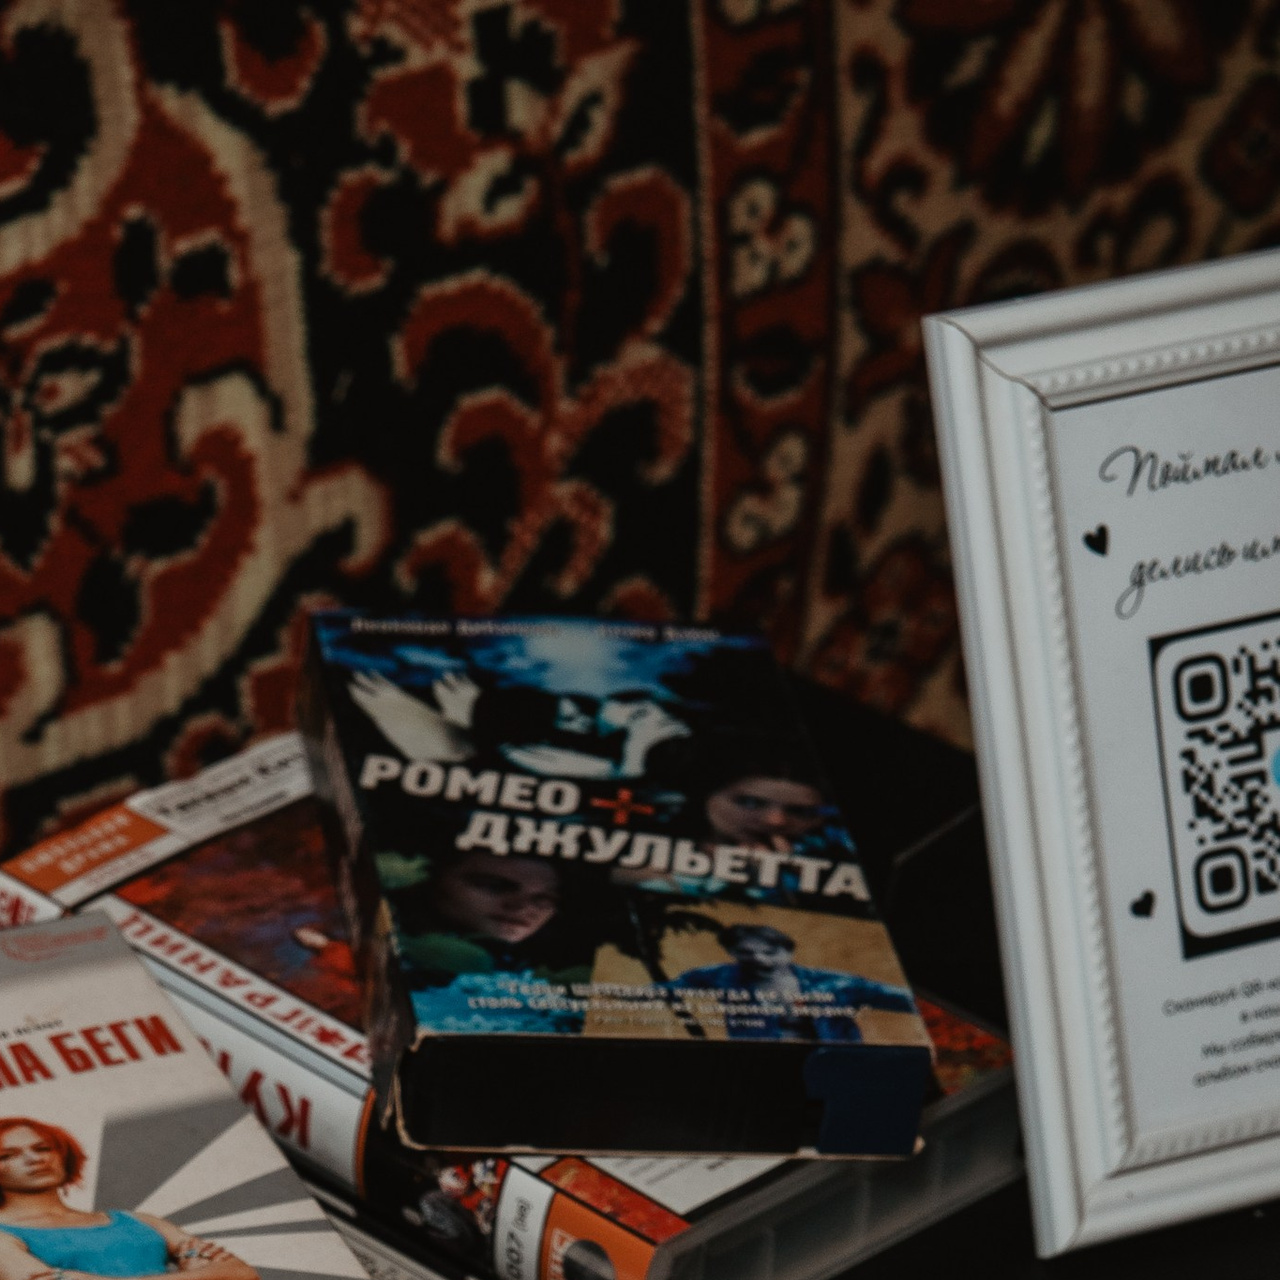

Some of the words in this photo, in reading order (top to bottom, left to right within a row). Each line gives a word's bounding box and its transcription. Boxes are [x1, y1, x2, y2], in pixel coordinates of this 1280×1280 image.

[357, 753, 581, 813] РОМЕО
[455, 808, 873, 901] ДЖУЛЬЕТТА
[50, 1014, 185, 1074] БЕГИ
